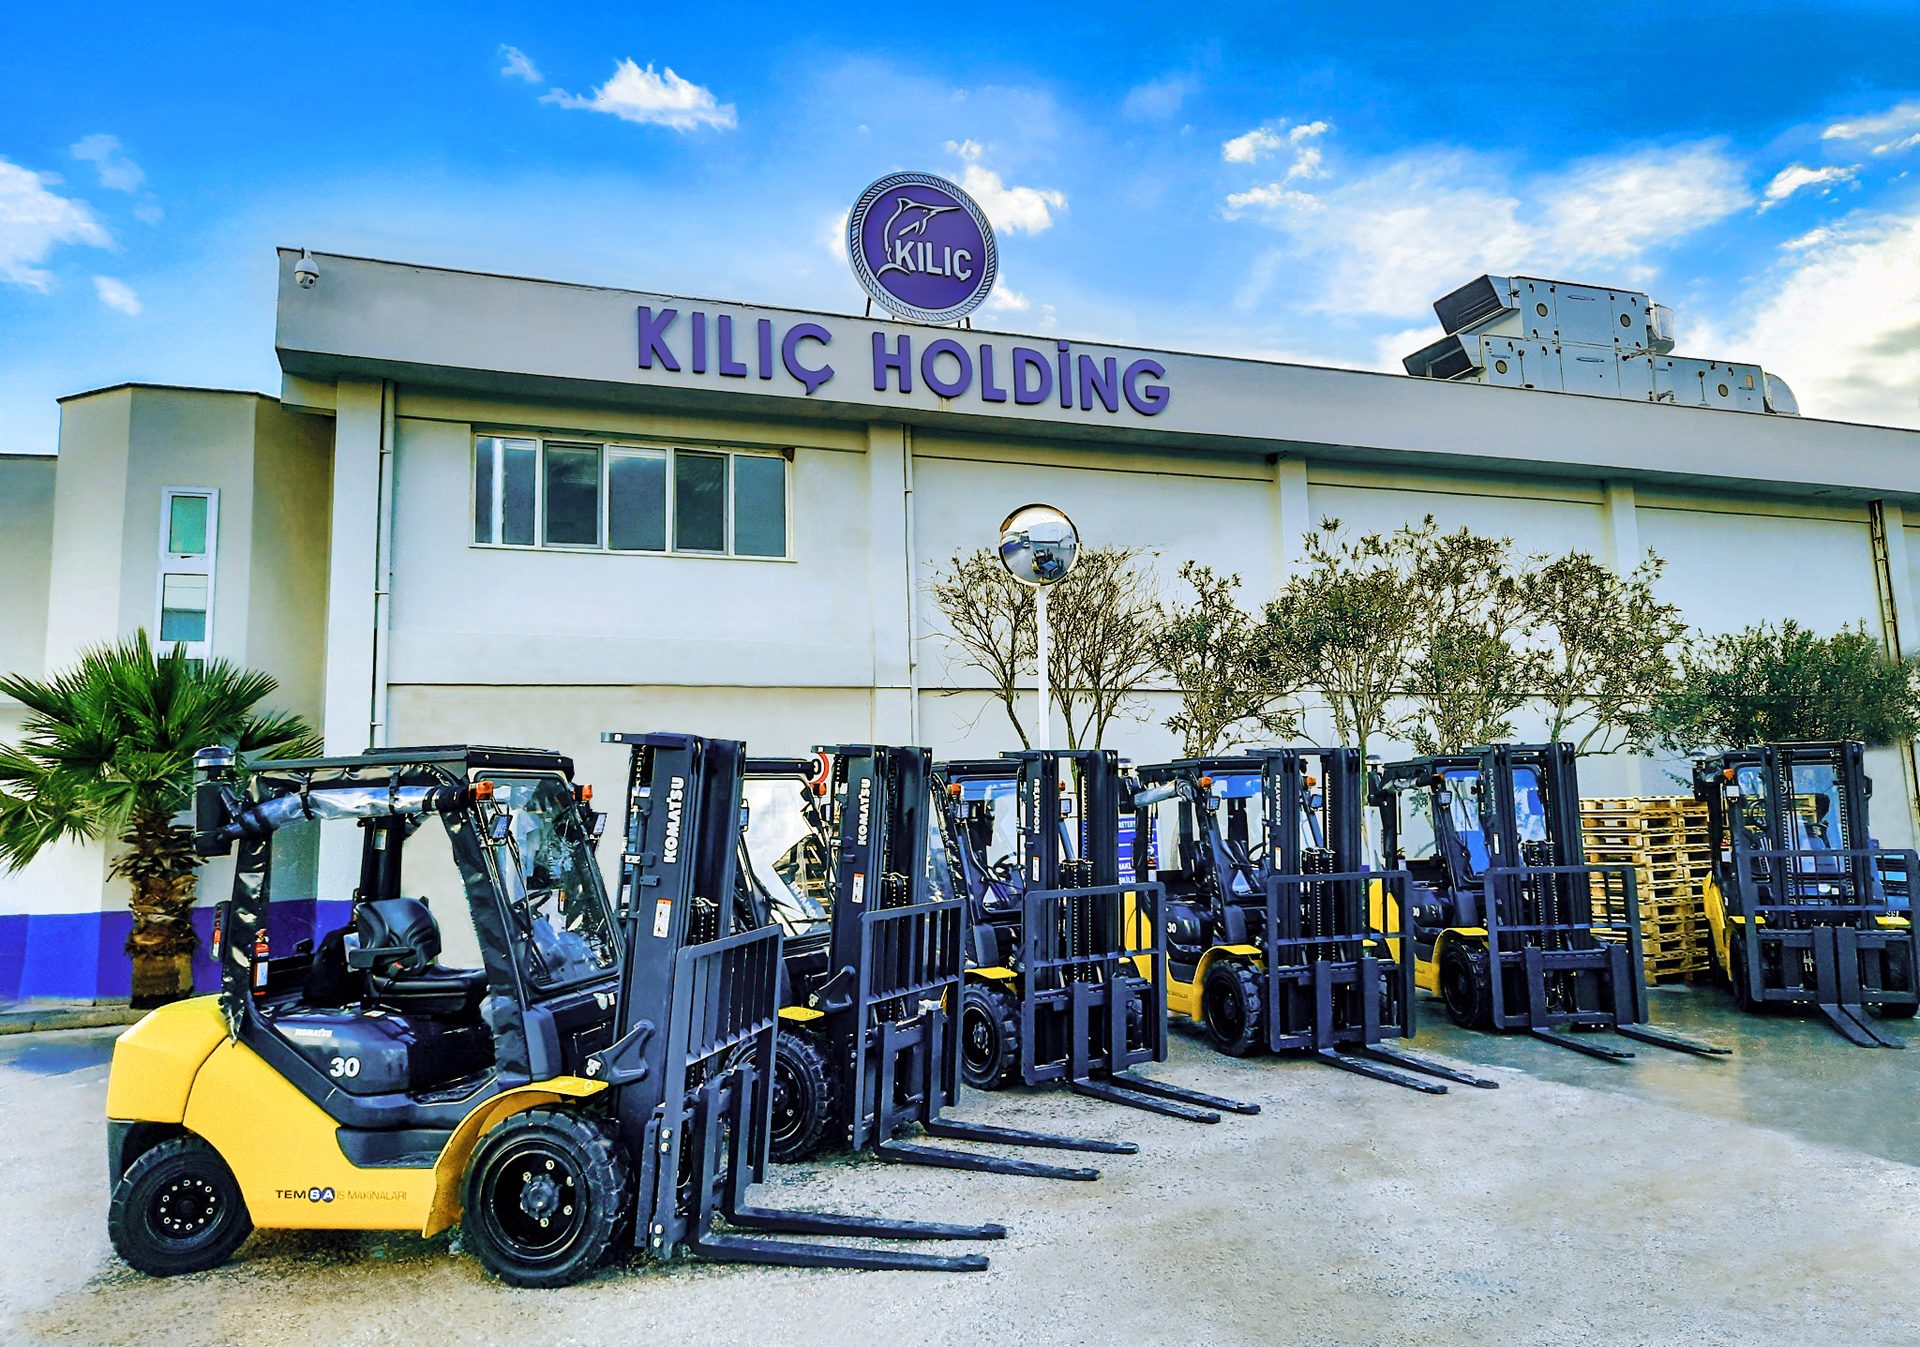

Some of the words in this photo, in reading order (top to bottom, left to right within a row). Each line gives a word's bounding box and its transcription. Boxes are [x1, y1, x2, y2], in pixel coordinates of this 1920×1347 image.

[895, 239, 972, 281] KILIÇ
[637, 305, 835, 395] KILIÇ
[663, 776, 685, 863] KOMATSU
[857, 778, 871, 845] KOMATSU
[1166, 921, 1177, 933] 30
[294, 1027, 334, 1037] KOMATSU
[329, 1056, 361, 1078] 30
[275, 1187, 335, 1203] TEMSA
